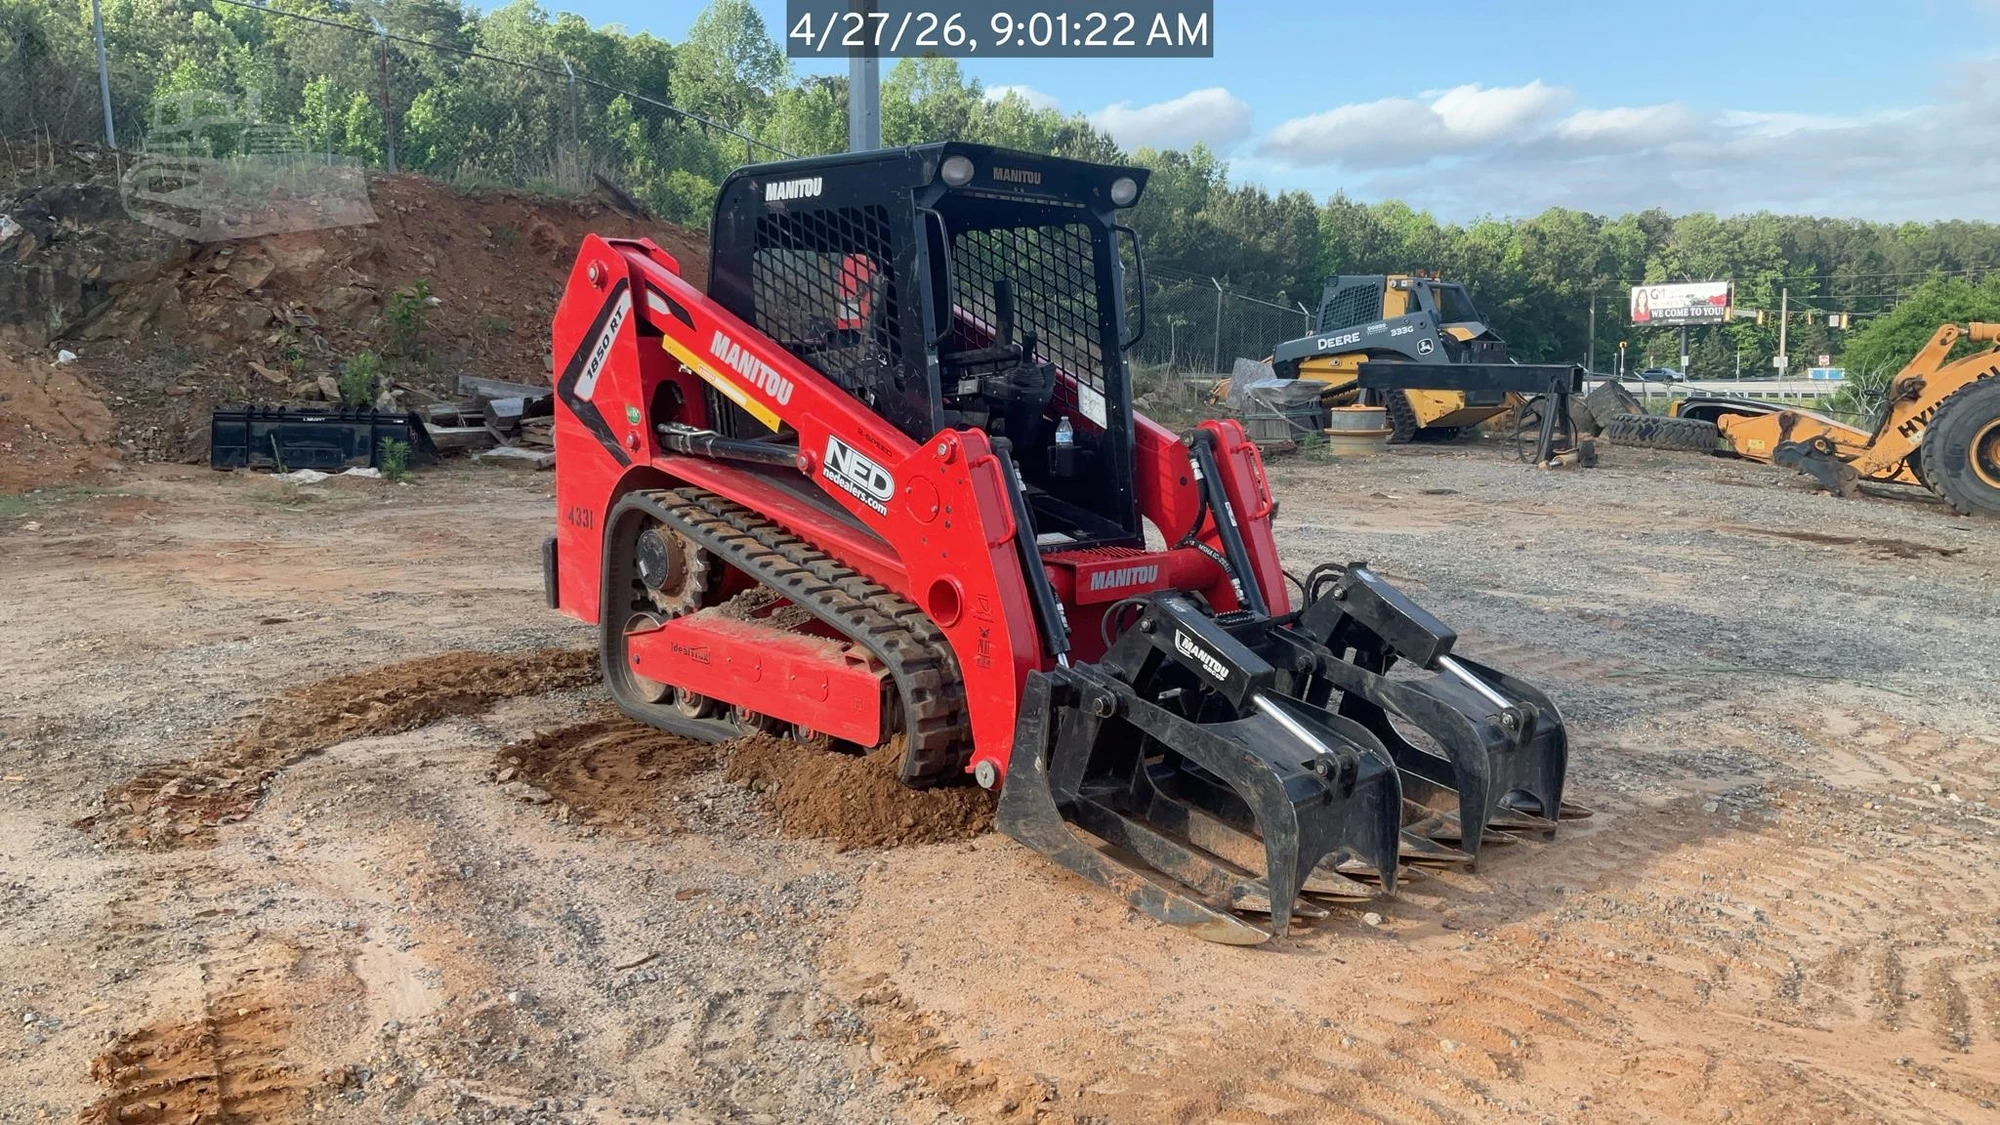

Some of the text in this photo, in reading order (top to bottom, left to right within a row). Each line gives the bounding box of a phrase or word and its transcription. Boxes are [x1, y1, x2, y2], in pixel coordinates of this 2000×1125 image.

[993, 167, 1042, 185] MANITOU
[765, 177, 823, 201] MANITOU
[1651, 306, 1724, 318] WE COME TO YOU!
[586, 304, 625, 380] 1850 RT
[1317, 332, 1361, 350] DEERE
[1390, 325, 1414, 337] 333G
[709, 330, 795, 406] MANITOU
[824, 438, 894, 500] NED
[823, 467, 888, 516] nedealers.com
[568, 506, 593, 530] 4331
[1090, 565, 1159, 591] MANITOU
[1181, 637, 1230, 678] MANITOU
